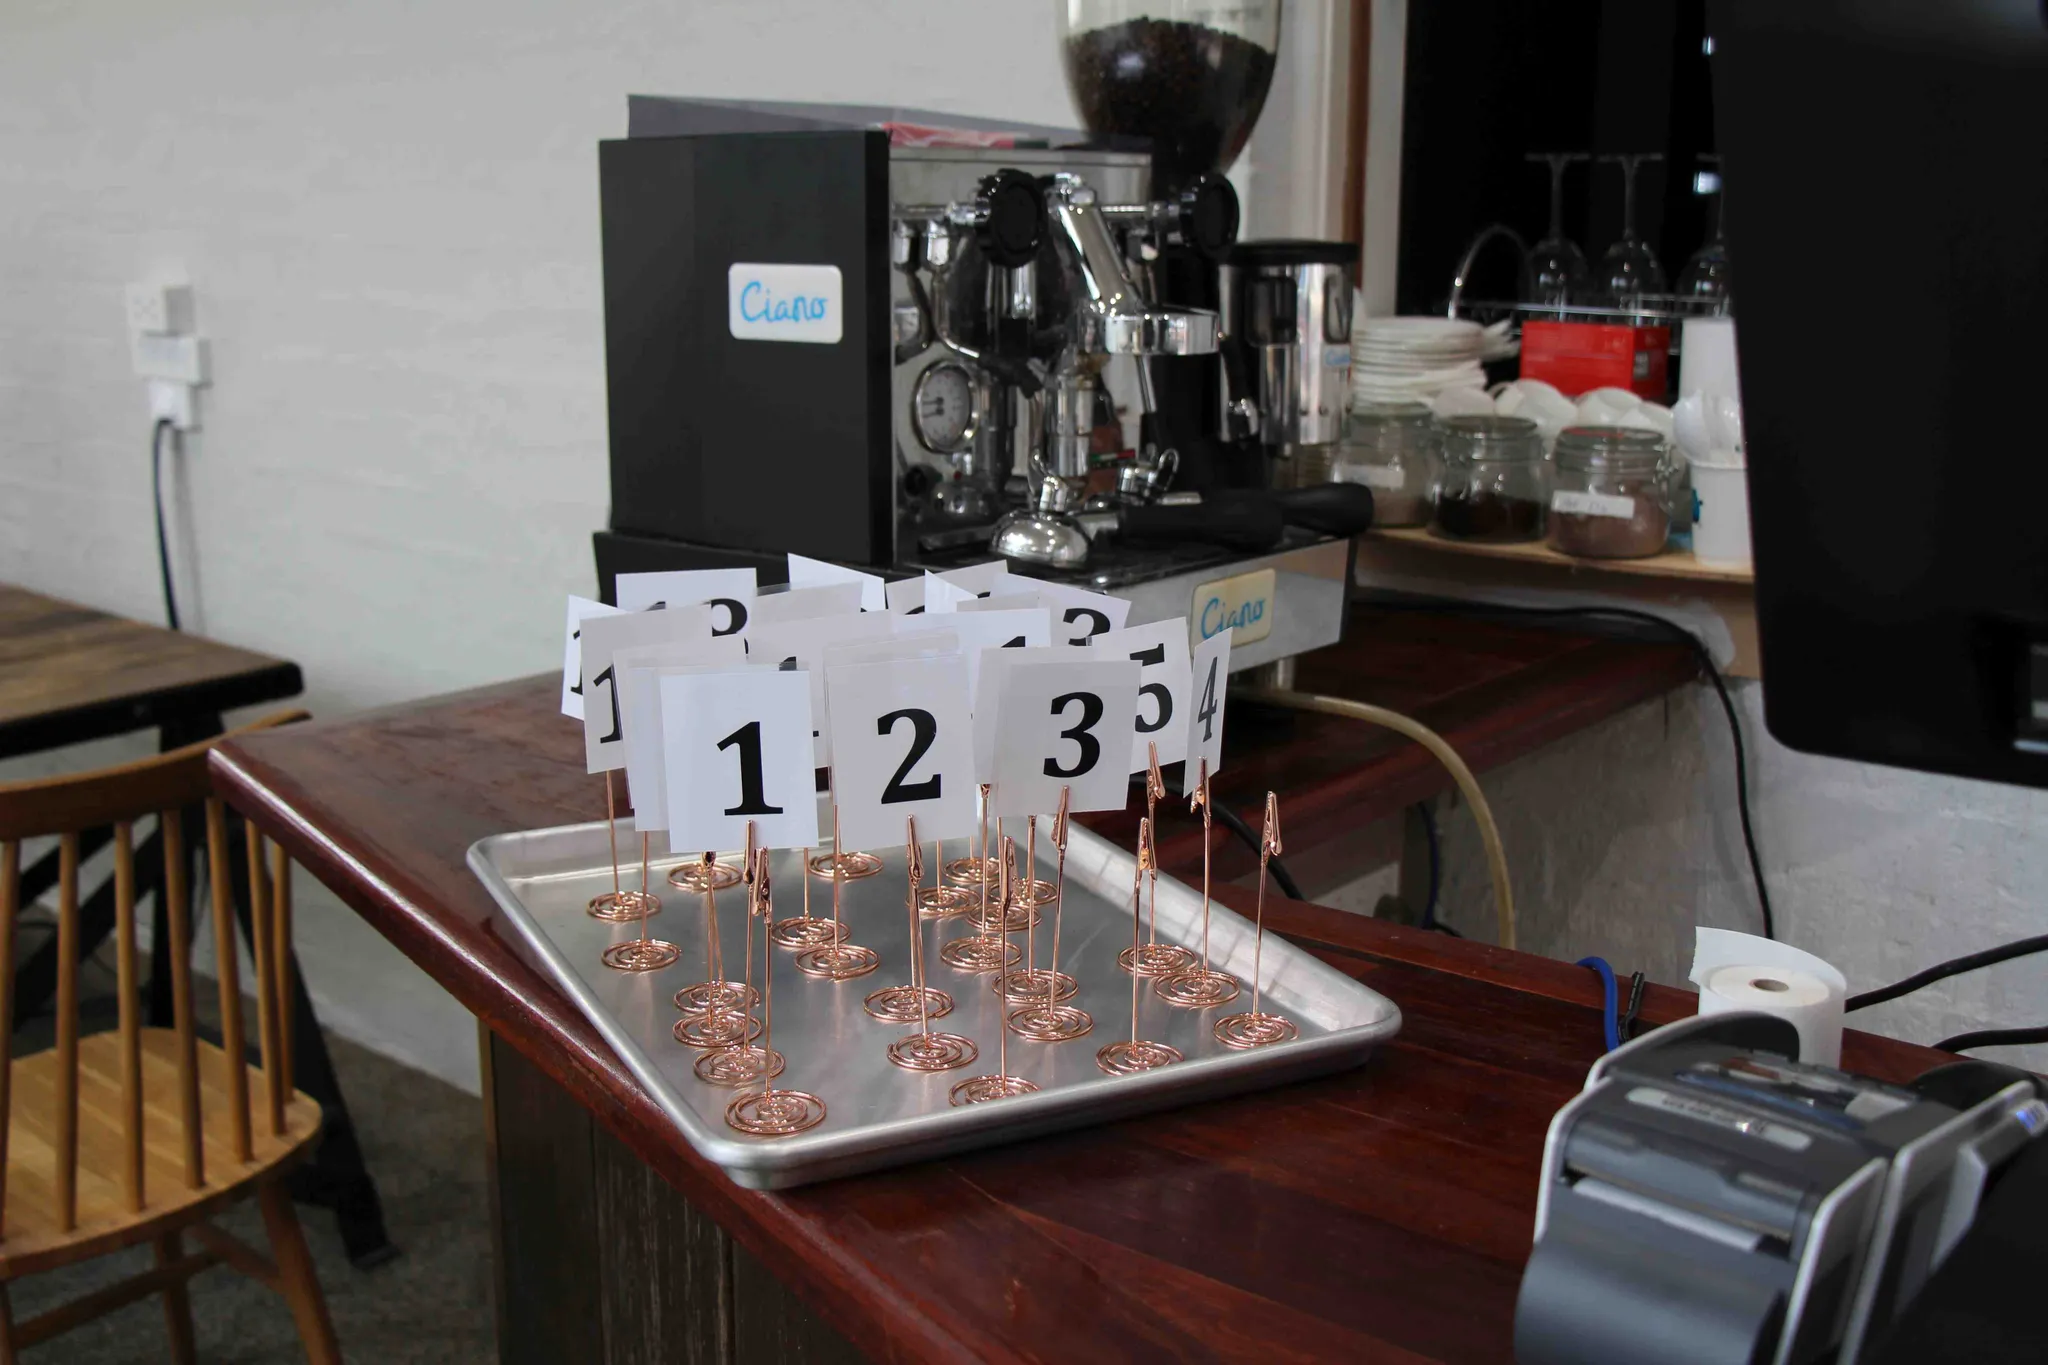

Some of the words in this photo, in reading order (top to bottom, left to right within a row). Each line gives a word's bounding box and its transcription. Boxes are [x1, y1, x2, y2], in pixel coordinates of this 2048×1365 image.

[740, 280, 828, 323] Ciano
[1201, 597, 1267, 640] Ciano
[1043, 691, 1104, 778] 3
[1197, 656, 1218, 742] 4
[716, 721, 784, 816] 1
[877, 708, 942, 804] 2
